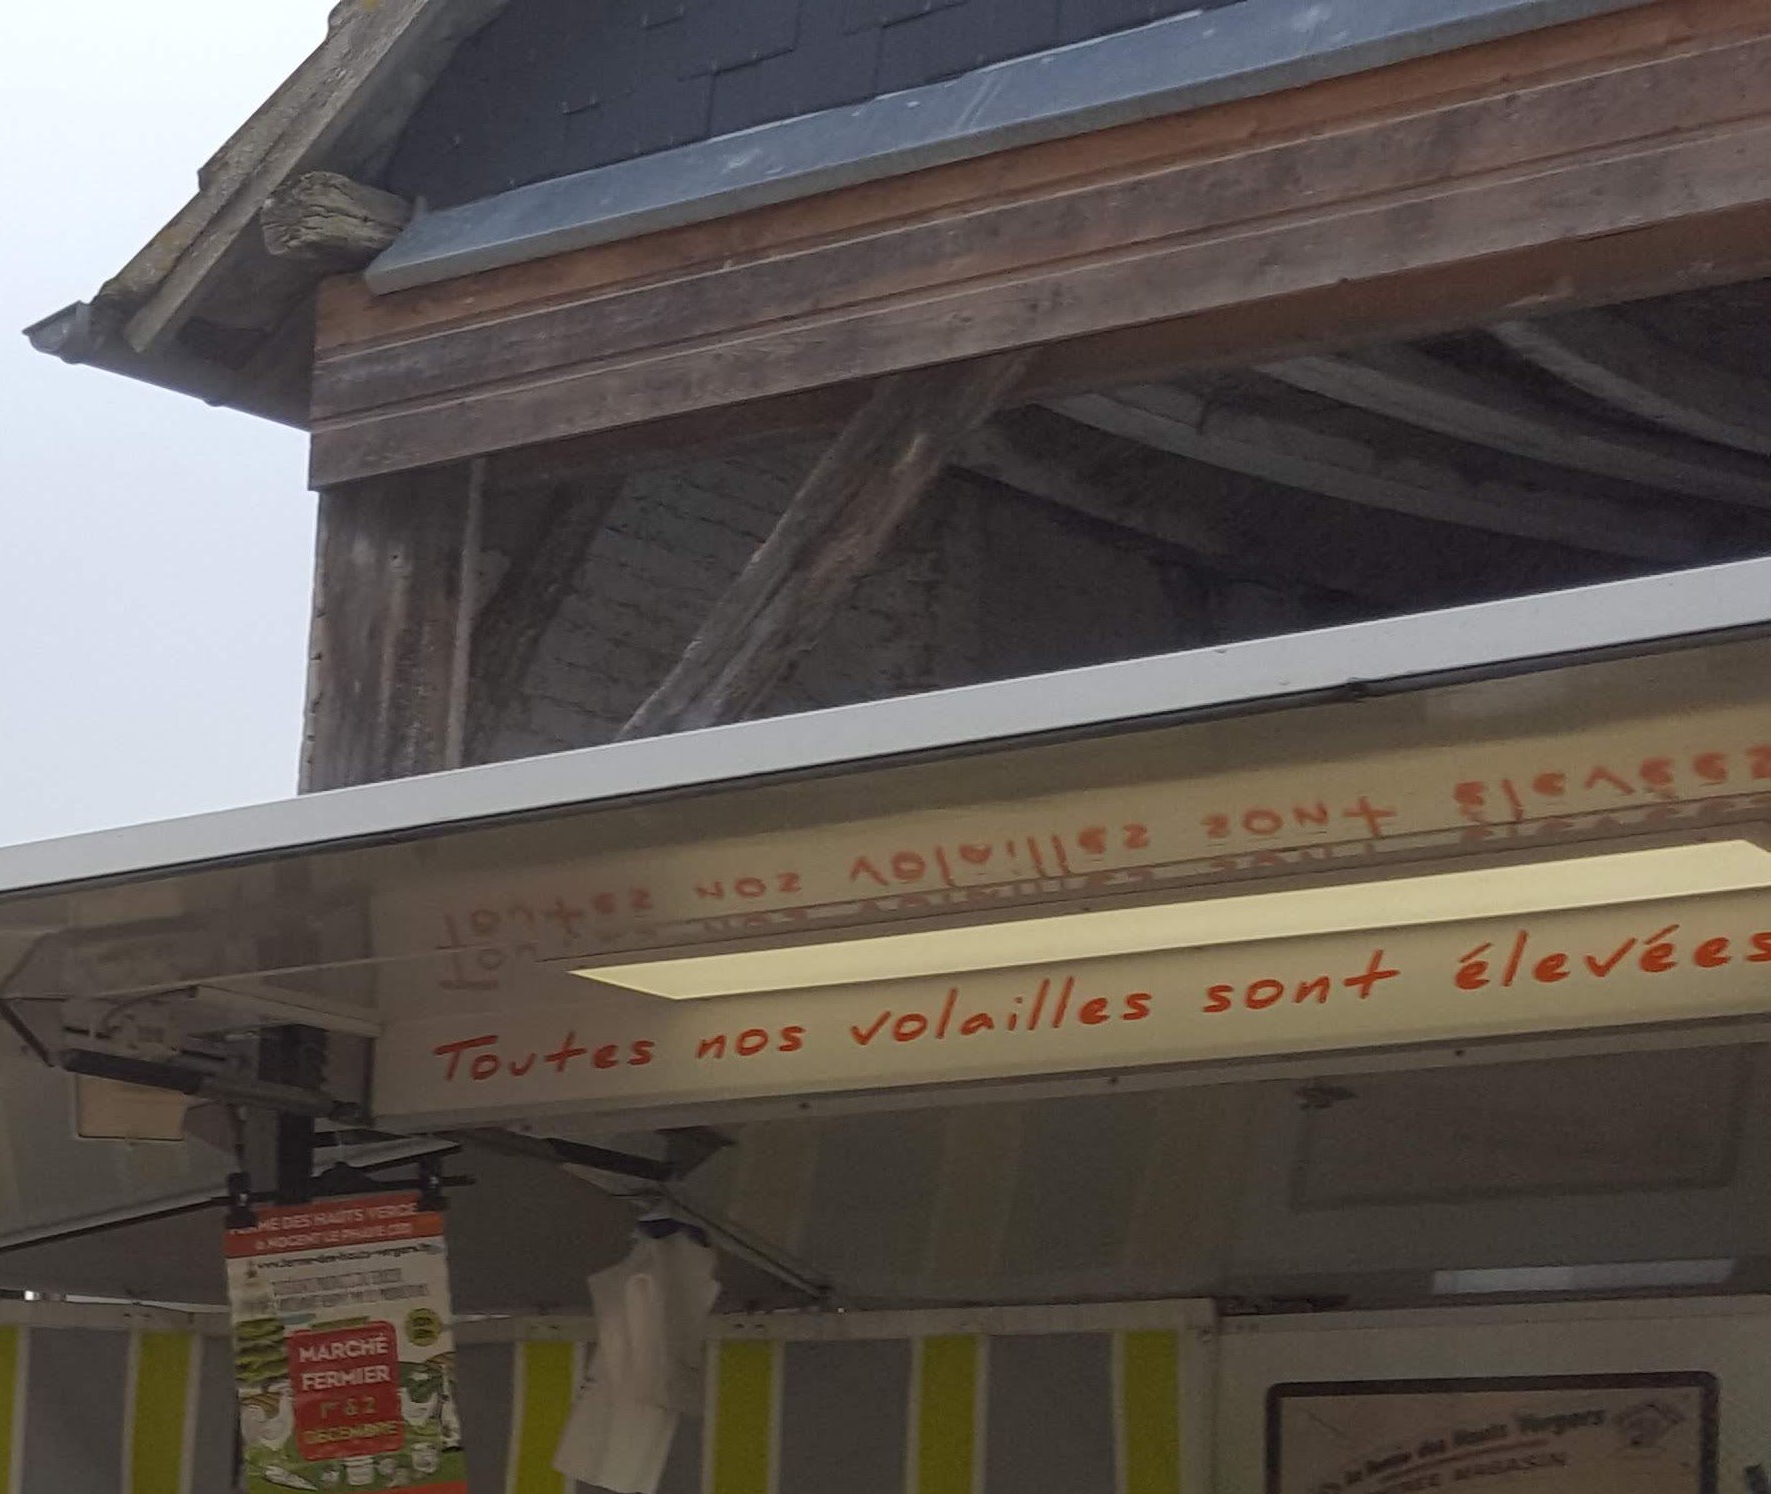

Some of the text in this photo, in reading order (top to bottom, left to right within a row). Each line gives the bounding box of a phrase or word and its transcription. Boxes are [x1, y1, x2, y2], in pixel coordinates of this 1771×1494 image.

[433, 924, 1771, 1082] Toutes nos volailles sont élevées
[299, 1332, 390, 1363] MARCHÉ
[302, 1364, 392, 1391] FERMIER
